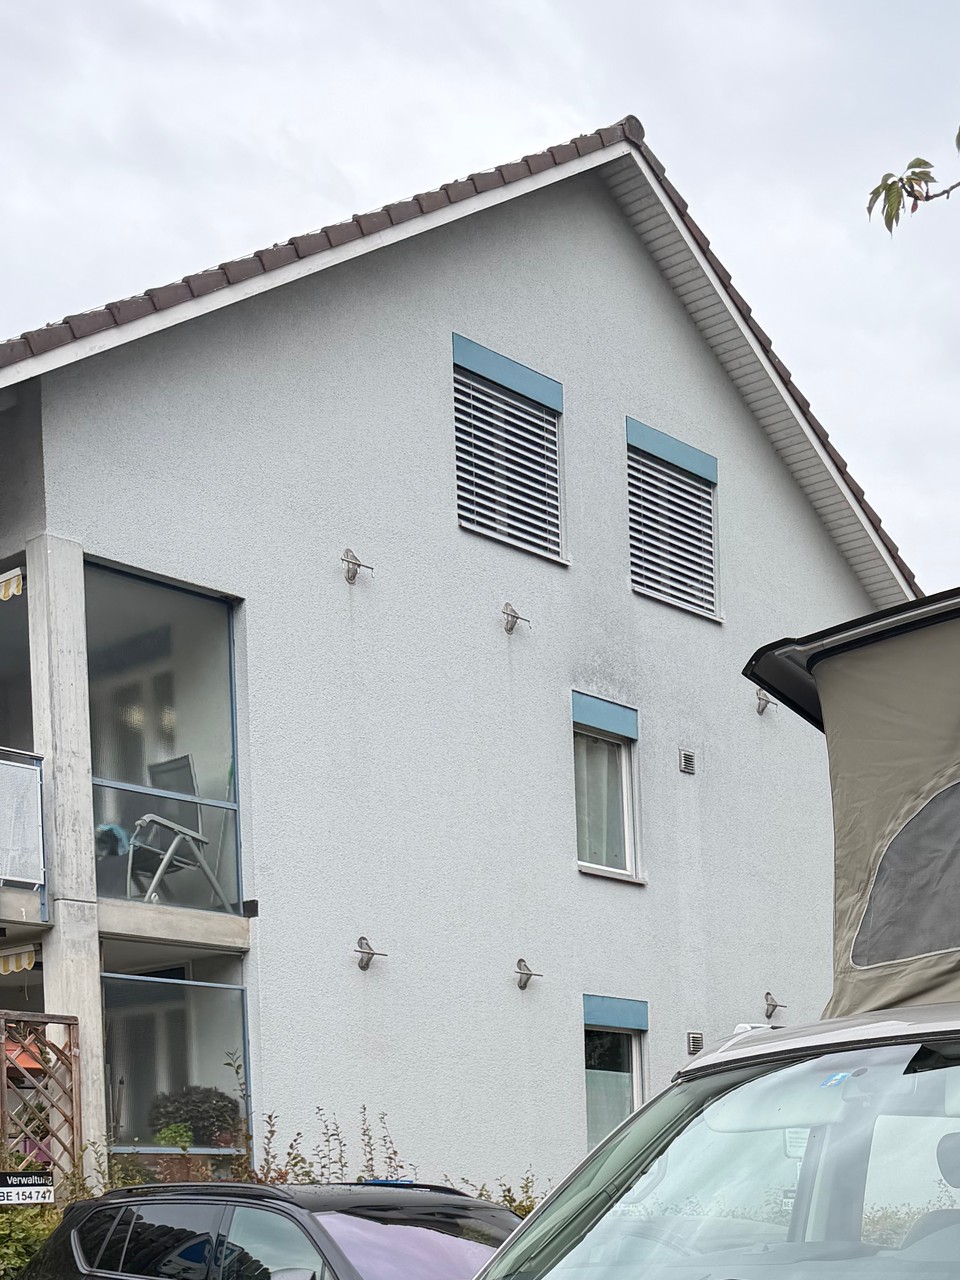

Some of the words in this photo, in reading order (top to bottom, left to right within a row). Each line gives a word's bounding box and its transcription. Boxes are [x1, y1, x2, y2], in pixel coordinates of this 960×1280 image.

[0, 1191, 13, 1201] BE
[15, 1191, 33, 1201] 154
[35, 1190, 52, 1201] 747
